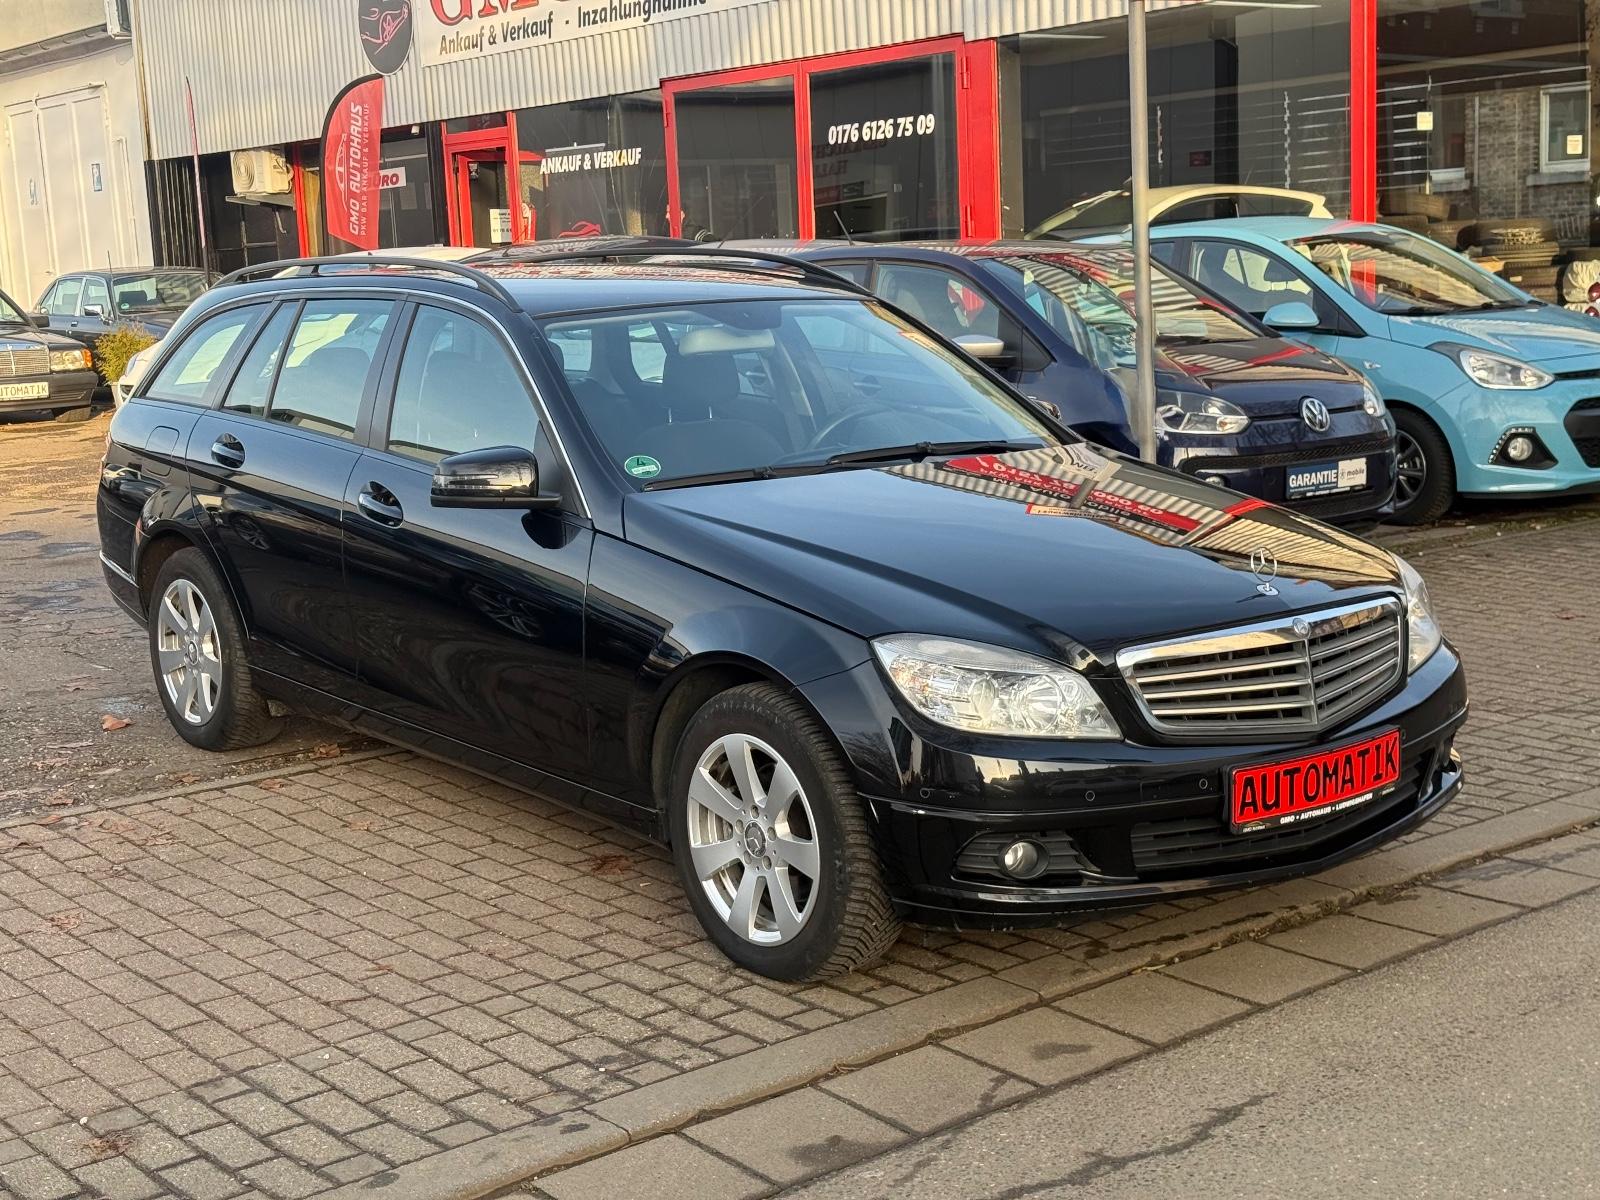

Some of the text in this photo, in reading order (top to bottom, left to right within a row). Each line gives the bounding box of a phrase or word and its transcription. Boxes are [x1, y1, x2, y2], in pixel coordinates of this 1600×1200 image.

[439, 25, 485, 56] Ankauf
[488, 31, 498, 46] &
[500, 11, 554, 43] Verkauf
[828, 113, 935, 145] 0176 6126 75 09
[350, 102, 363, 236] GMO AUTOHAUS
[361, 156, 369, 193] ANKAUF
[540, 147, 642, 175] ANKAUF & VERKAUF
[0, 384, 48, 397] UTOMATIK
[1289, 469, 1338, 488] GARANTIE
[1239, 737, 1398, 817] AUTOMATIK
[1300, 806, 1331, 820] AUTOHAUS
